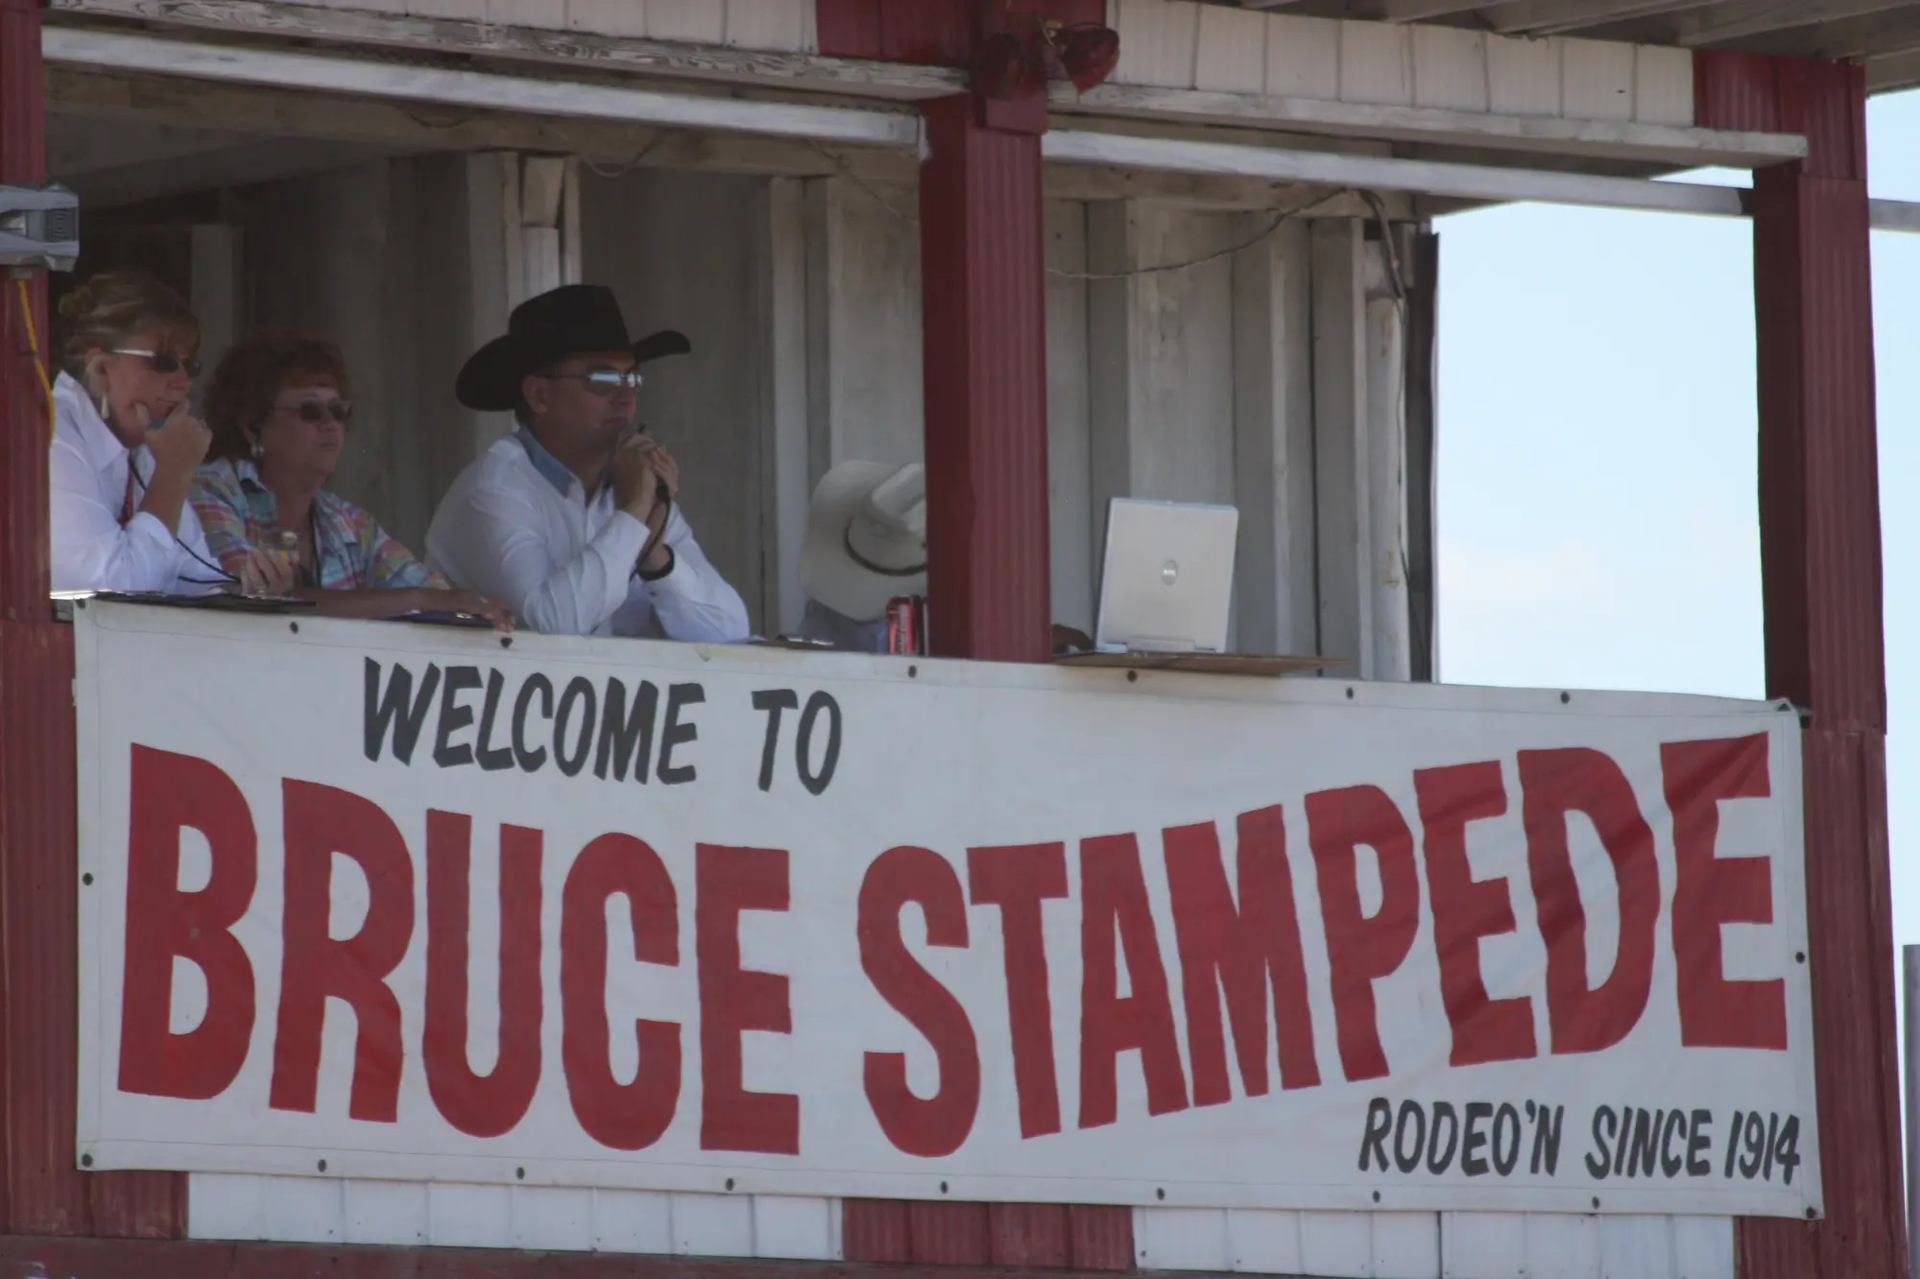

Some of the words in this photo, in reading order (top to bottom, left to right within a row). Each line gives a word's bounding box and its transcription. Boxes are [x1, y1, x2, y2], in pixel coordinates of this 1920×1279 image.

[364, 655, 707, 786] WELCOME
[751, 688, 843, 796] TO
[118, 742, 799, 1155] BRUCE
[858, 732, 1788, 1157] STAMPEDE
[1357, 1096, 1565, 1178] RODEO'N
[1583, 1104, 1713, 1180] SINCE
[1723, 1110, 1802, 1186] 1914
